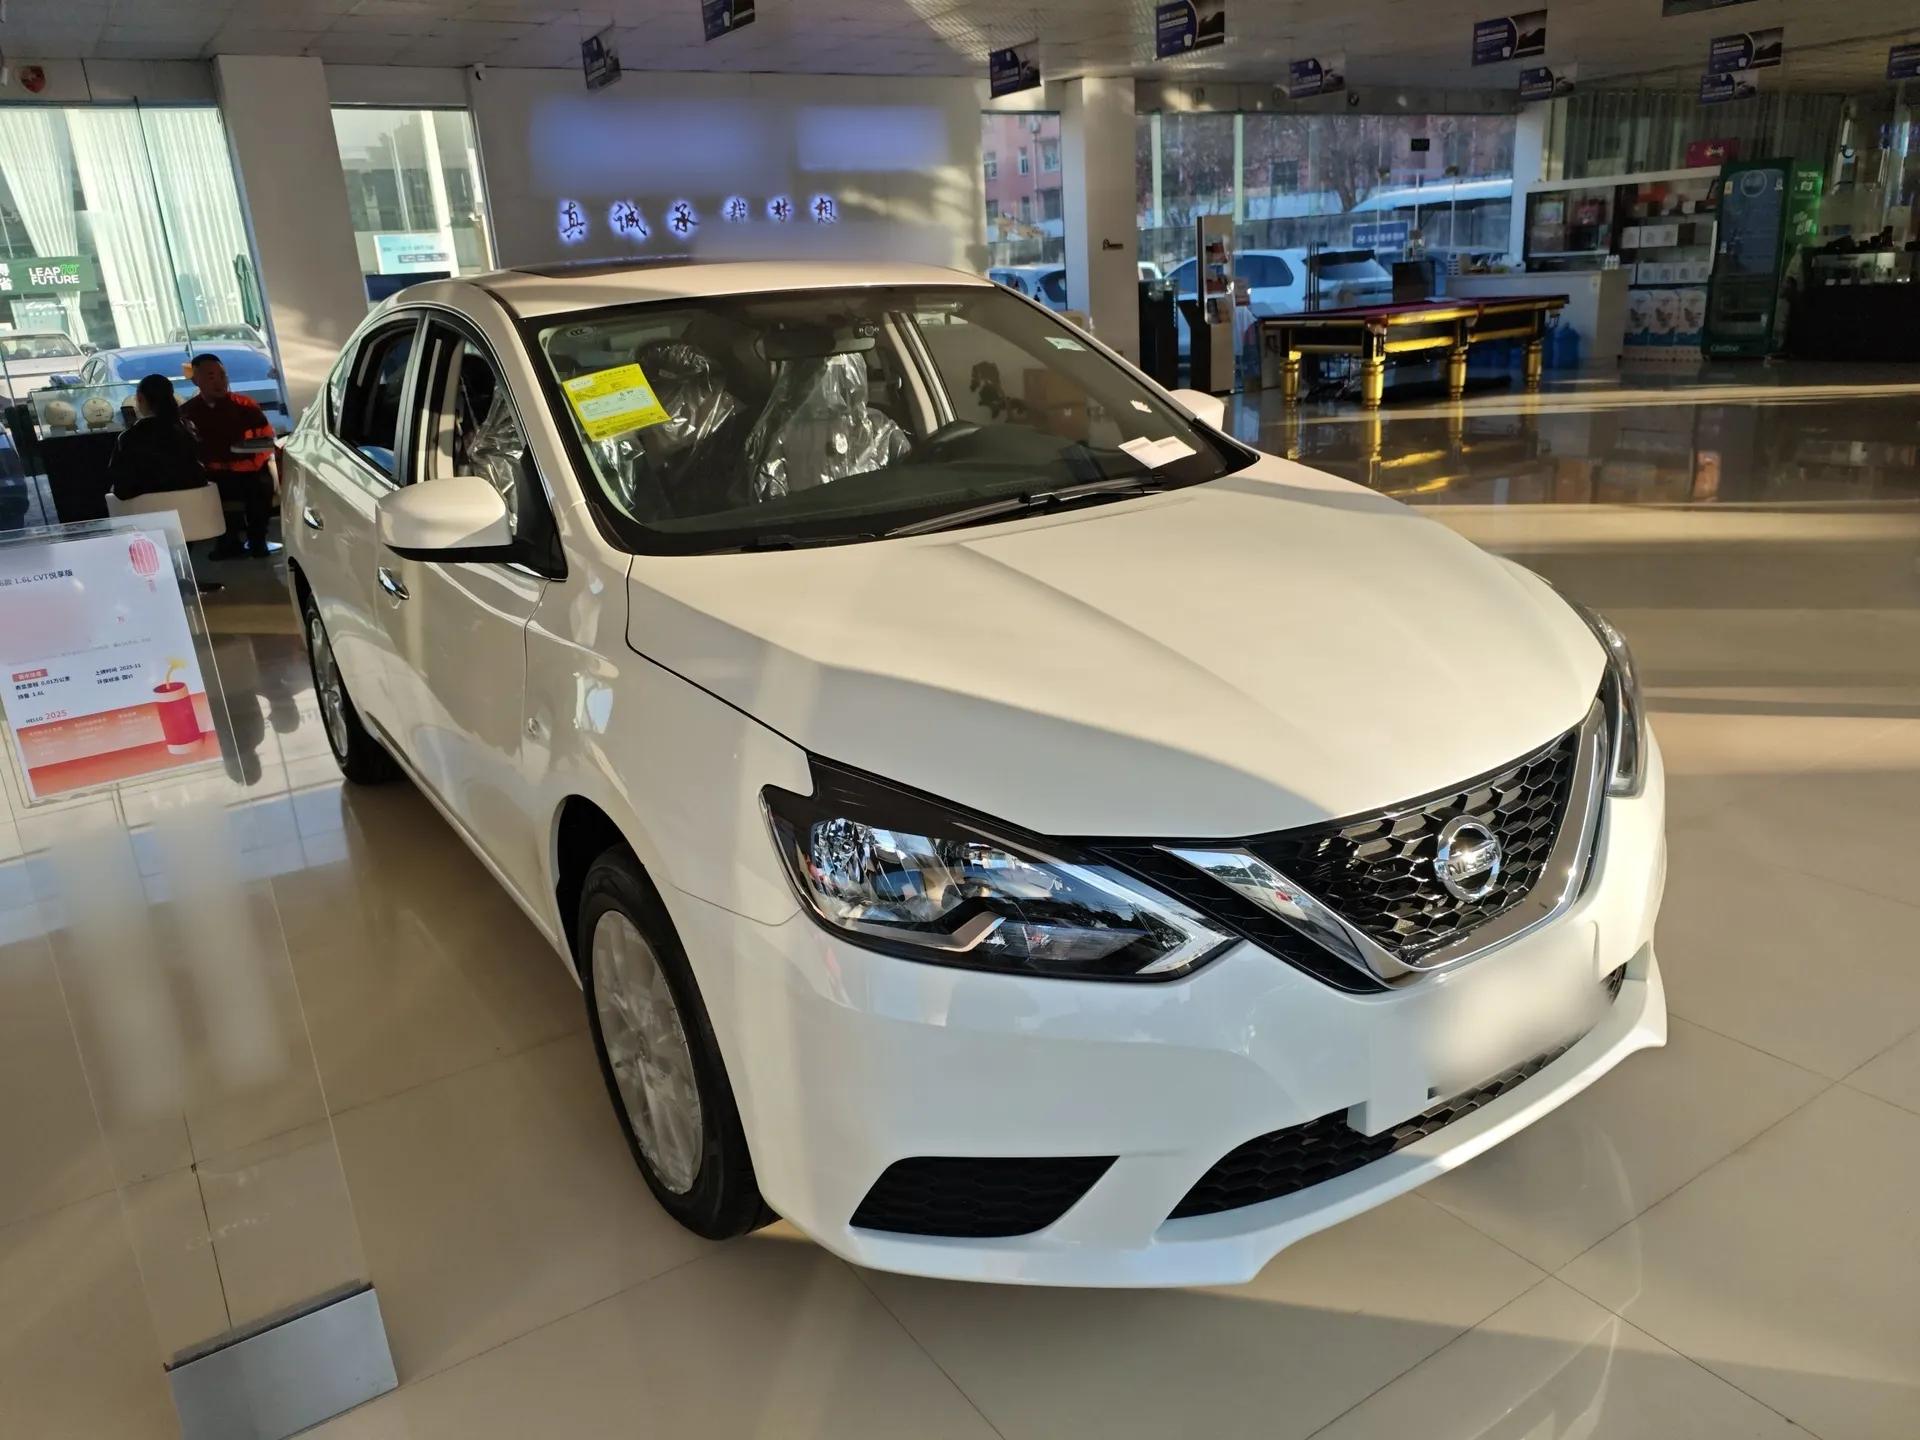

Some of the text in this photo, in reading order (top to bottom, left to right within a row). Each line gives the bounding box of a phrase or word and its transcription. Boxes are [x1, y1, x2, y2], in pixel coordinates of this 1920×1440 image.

[28, 265, 60, 277] LEAP
[31, 275, 80, 286] FUTURE
[45, 709, 67, 720] 2025
